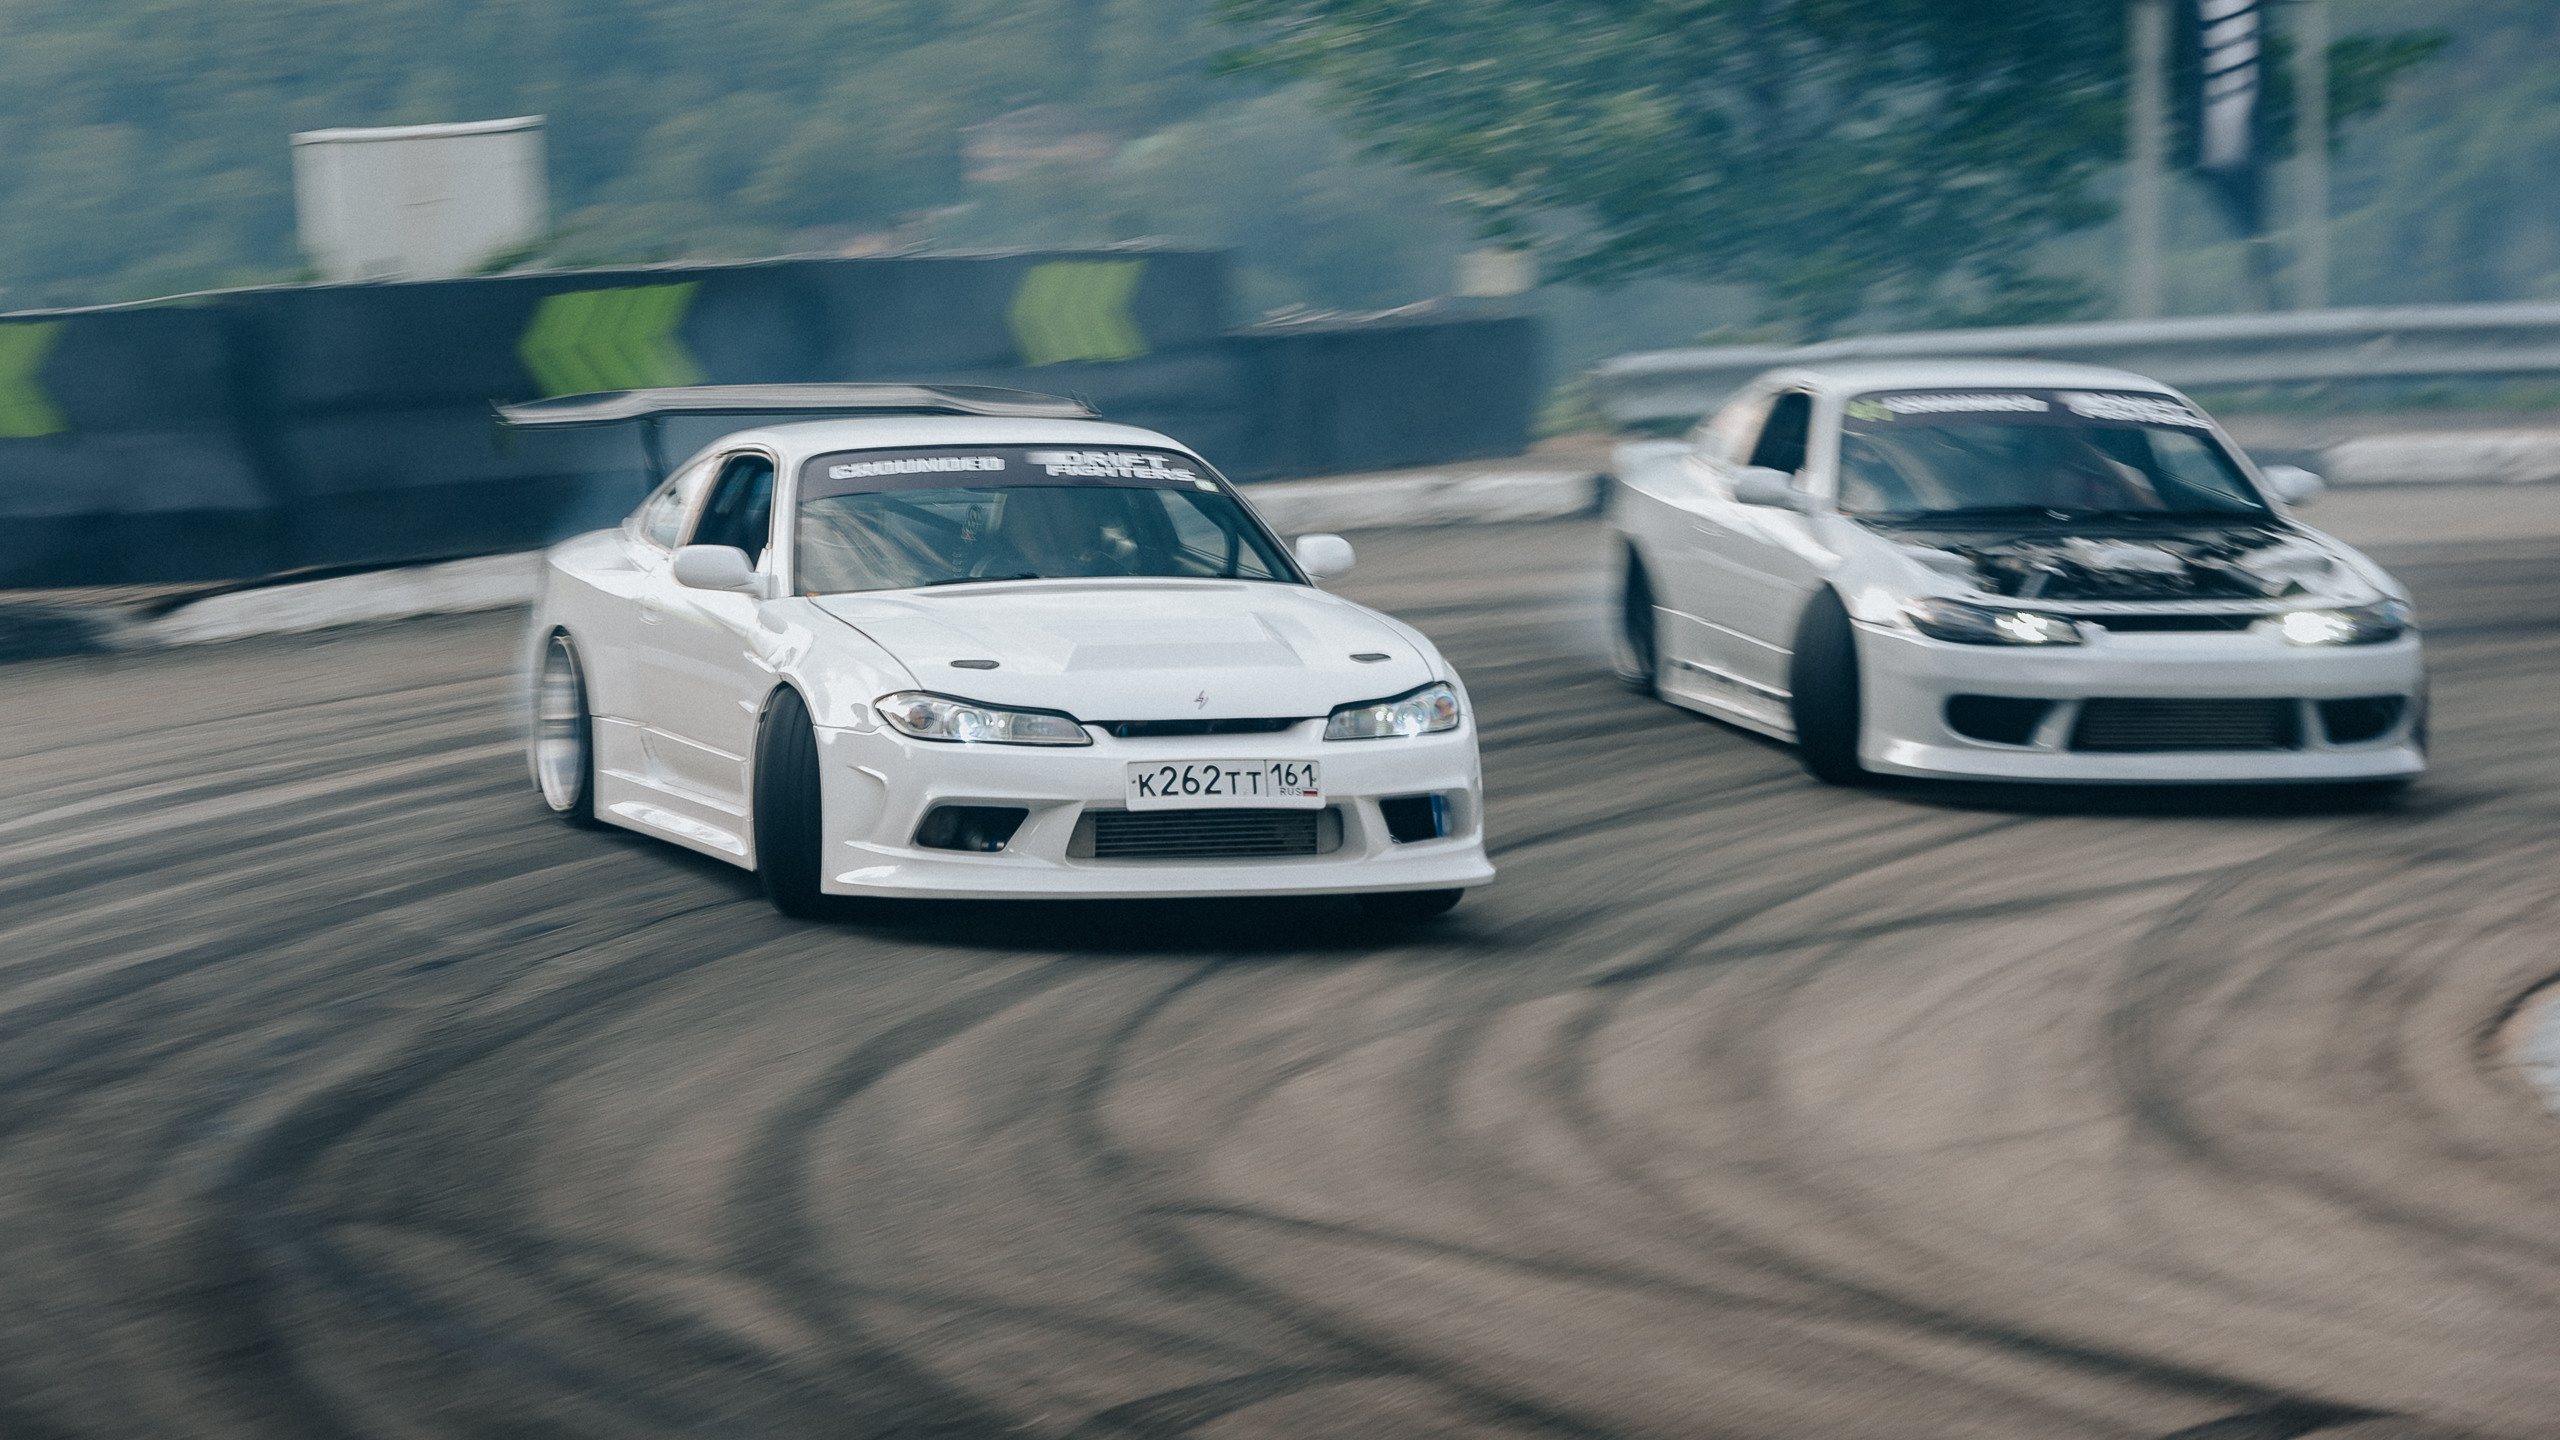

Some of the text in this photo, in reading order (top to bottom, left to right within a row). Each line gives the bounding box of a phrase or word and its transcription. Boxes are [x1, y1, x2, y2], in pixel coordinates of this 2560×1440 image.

[1062, 451, 1169, 468] DRIFT
[1270, 763, 1314, 787] 161
[1280, 788, 1302, 796] RUS
